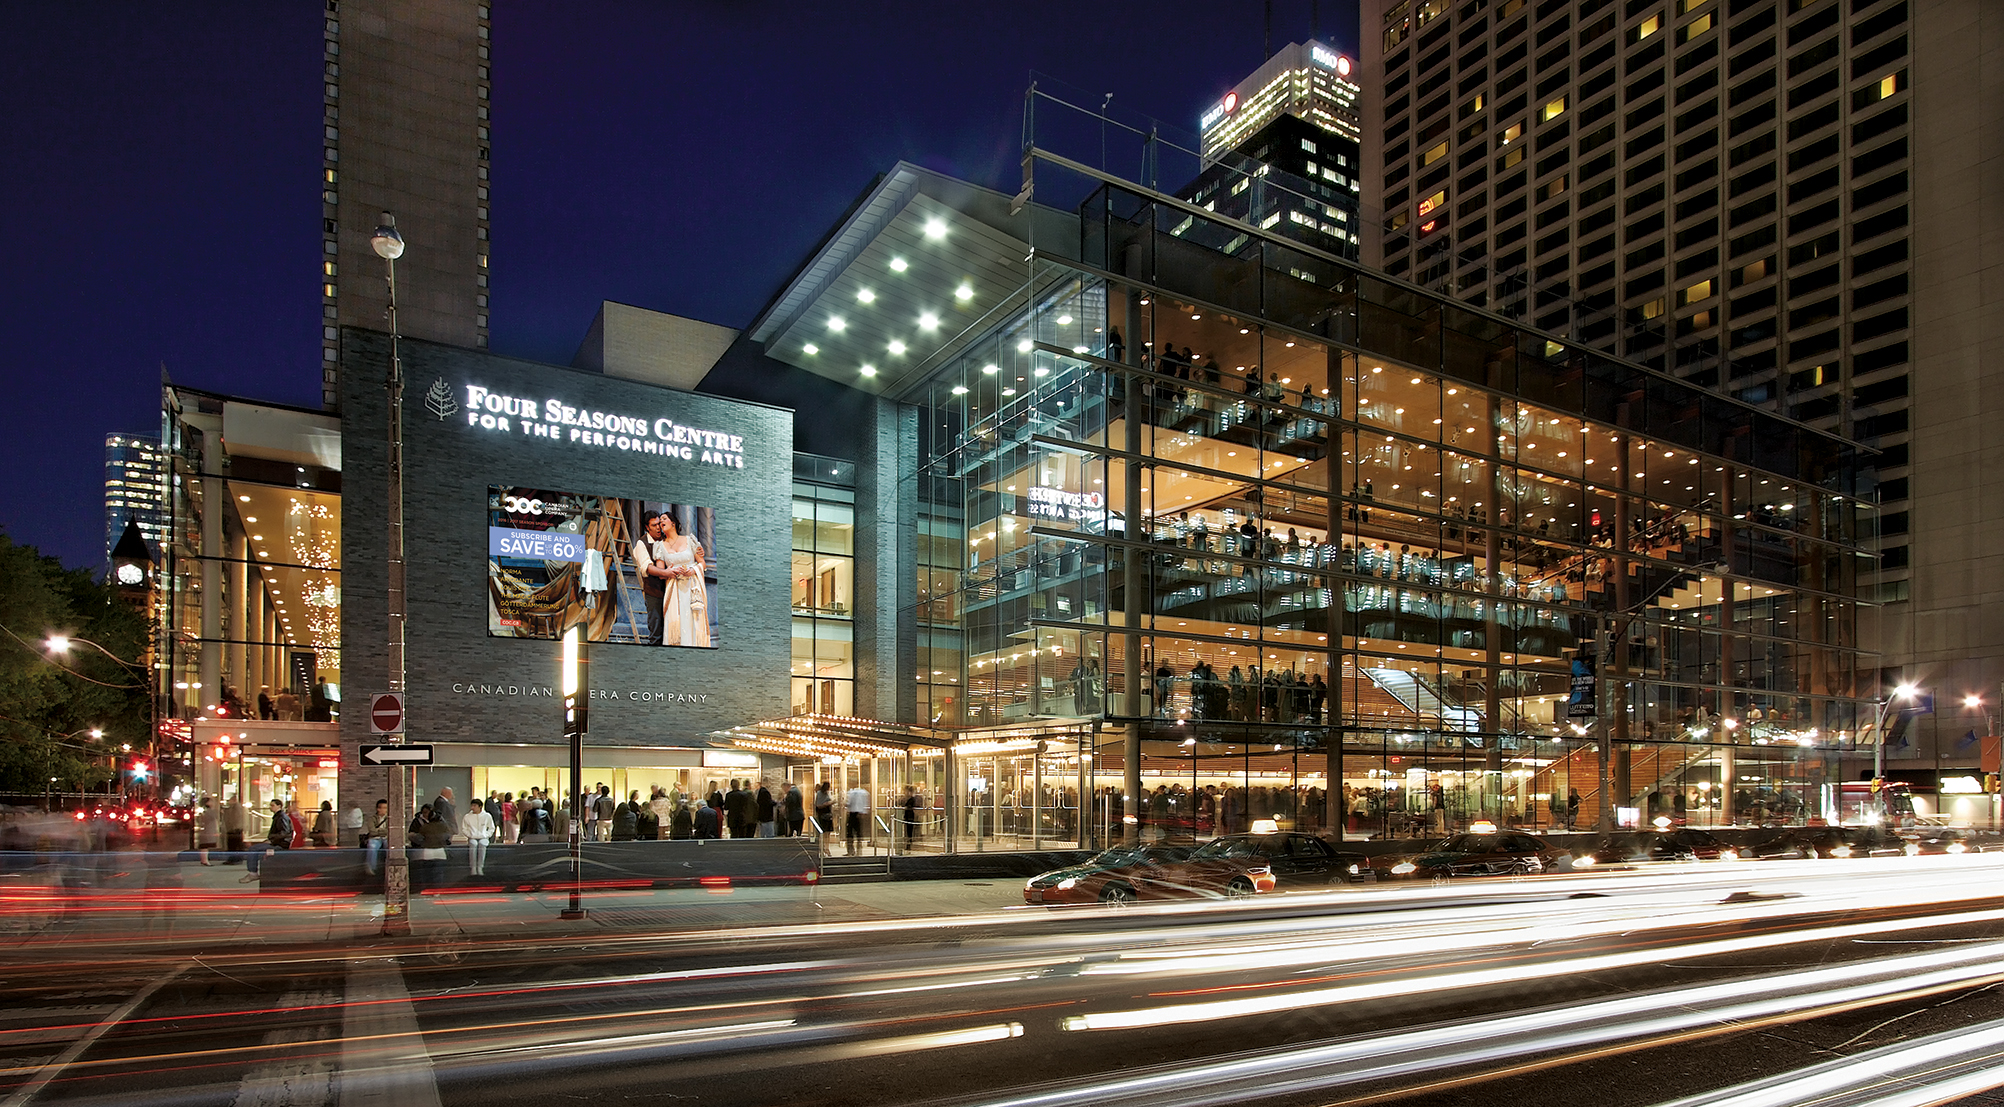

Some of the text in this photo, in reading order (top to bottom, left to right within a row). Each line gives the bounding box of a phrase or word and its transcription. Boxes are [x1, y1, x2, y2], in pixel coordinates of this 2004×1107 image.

[1312, 45, 1338, 69] BMO
[1201, 103, 1224, 130] BMO
[466, 385, 743, 453] FOUR SEASONS CENTRE
[468, 412, 744, 469] FOR THE PERFORMING ARTS
[545, 501, 569, 509] CANADIAN
[500, 537, 545, 556] SAVE
[510, 531, 570, 543] SUBSCRIBE AND
[500, 576, 534, 584] ARIODANTE
[452, 683, 708, 704] CANADIAN ERA COMPANY
[269, 746, 314, 755] Box Office
